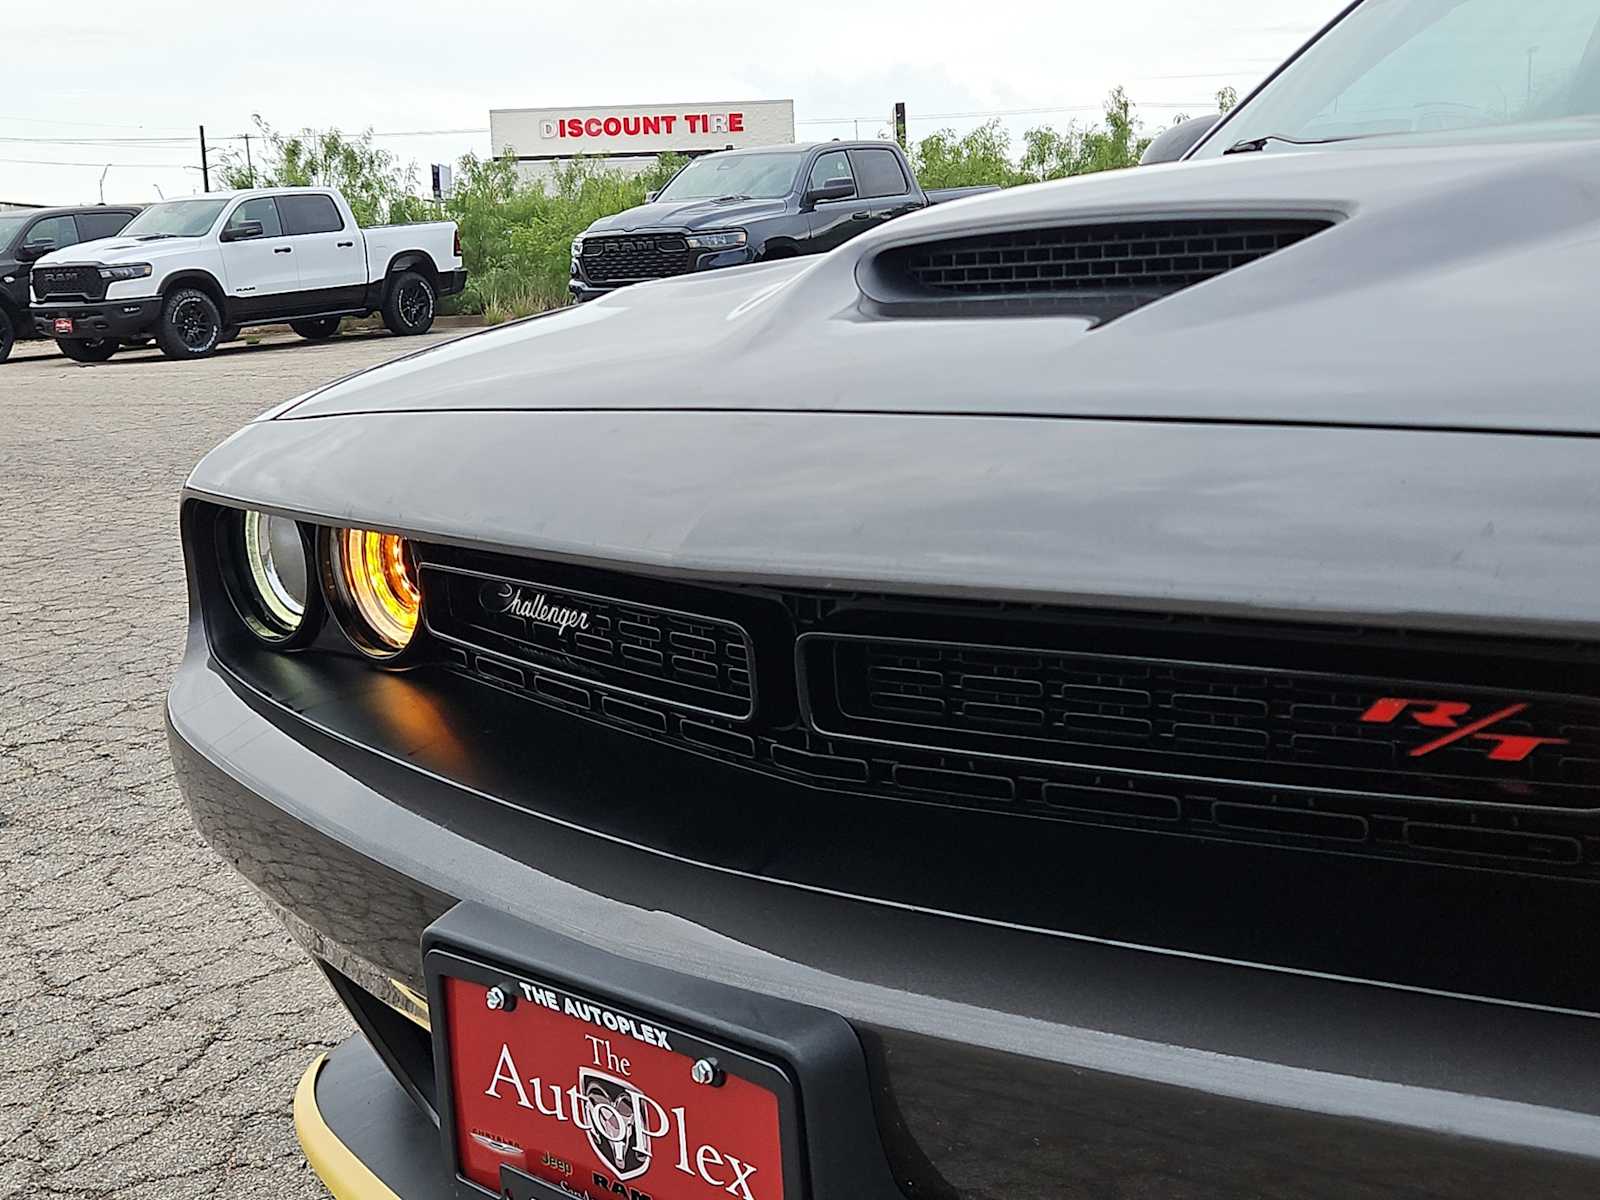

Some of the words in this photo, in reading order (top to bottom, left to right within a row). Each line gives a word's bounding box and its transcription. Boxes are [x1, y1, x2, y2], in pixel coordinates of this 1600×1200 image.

[540, 114, 677, 139] DISCOUNT
[684, 112, 744, 134] TIRE
[604, 240, 655, 252] RAM
[44, 272, 79, 281] RAM
[480, 582, 590, 636] Challenger
[1360, 697, 1570, 762] R/T
[519, 981, 561, 1011] THE
[563, 997, 673, 1051] AUTOPLEX
[584, 1033, 632, 1076] The
[484, 1042, 758, 1200] AutoPlex
[541, 1151, 574, 1177] Jeep
